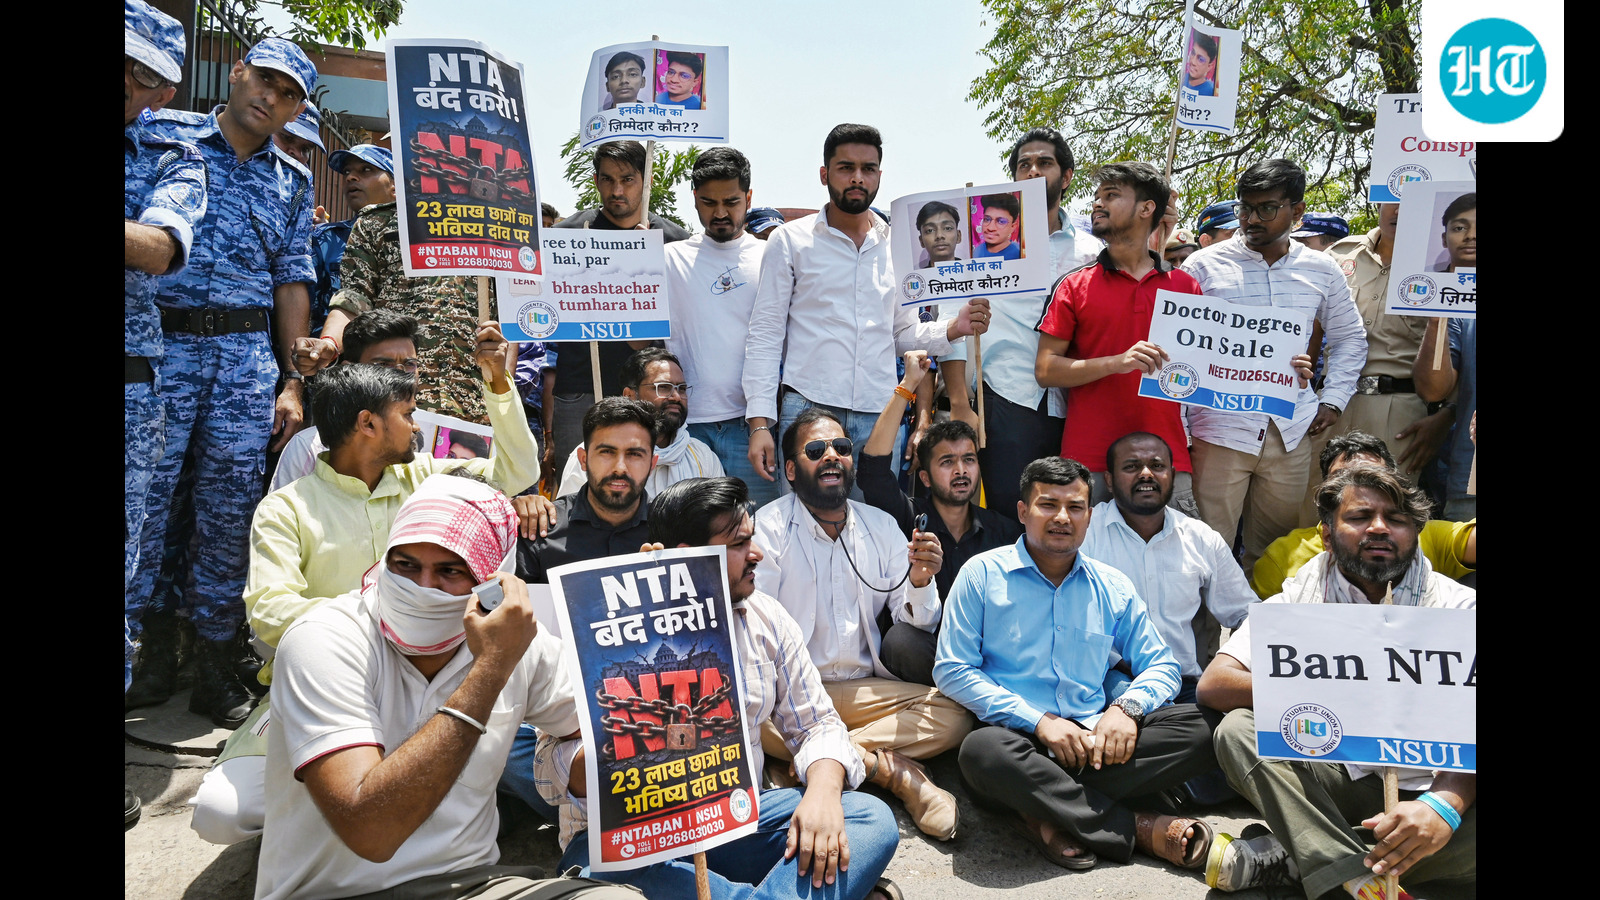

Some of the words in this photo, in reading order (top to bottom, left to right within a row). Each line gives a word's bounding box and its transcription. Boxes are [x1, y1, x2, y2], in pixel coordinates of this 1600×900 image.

[428, 53, 505, 92] NTA
[413, 82, 461, 112] बंद
[466, 85, 520, 123] करो!
[618, 104, 645, 116] इनकी
[648, 104, 667, 116] मौत
[669, 108, 683, 117] का
[1394, 99, 1422, 113] Tr
[658, 119, 699, 132] कौन??
[1401, 136, 1476, 157] Consp
[417, 131, 531, 200] NTA
[416, 201, 442, 218] 23
[446, 204, 485, 218] लाख
[488, 206, 516, 224] छात्रों
[518, 212, 533, 227] का
[428, 218, 483, 237] भविष्य
[488, 223, 511, 240] दांव
[514, 229, 530, 243] पर
[417, 245, 478, 256] #NTABAN
[489, 247, 512, 259] NSUI
[570, 239, 586, 249] to
[591, 237, 646, 249] humari
[457, 257, 512, 269] 9268030030
[553, 253, 580, 267] hai,
[585, 256, 610, 268] par
[937, 262, 964, 277] इनकी
[966, 260, 985, 272] मौत
[989, 260, 1003, 270] का
[552, 281, 660, 294] bhrashtachar
[977, 274, 1020, 289] कौन??
[544, 305, 556, 318] UNION
[559, 298, 627, 311] tumhara
[632, 297, 656, 310] hai
[1162, 300, 1227, 325] Doctor
[1230, 313, 1301, 336] Degree
[580, 323, 632, 339] NSUI
[1176, 328, 1213, 351] On
[1218, 337, 1274, 358] Sale
[1208, 363, 1293, 388] NEET2026SCAM
[1212, 392, 1265, 411] NSUI
[600, 562, 697, 611] NTA
[590, 609, 649, 647] बंद
[650, 597, 718, 636] करो!
[1267, 644, 1368, 681] Ban
[603, 667, 736, 761] NTA
[1321, 710, 1338, 728] UNION
[1283, 723, 1304, 752] NATIONAL
[1333, 729, 1340, 739] OF
[1321, 739, 1337, 753] INDIA
[1377, 739, 1463, 767] NSUI
[611, 768, 641, 794] 23
[643, 759, 686, 783] लाख
[688, 744, 721, 773] छात्रों
[723, 743, 741, 761] का
[624, 785, 688, 815] भविष्य
[690, 773, 718, 798] दांव
[720, 766, 741, 786] पर
[611, 816, 683, 845] #NTABAN
[695, 803, 722, 824] NSUI
[658, 819, 725, 848] 9268030030
[637, 840, 651, 848] TOLL
[637, 845, 652, 854] FREE
